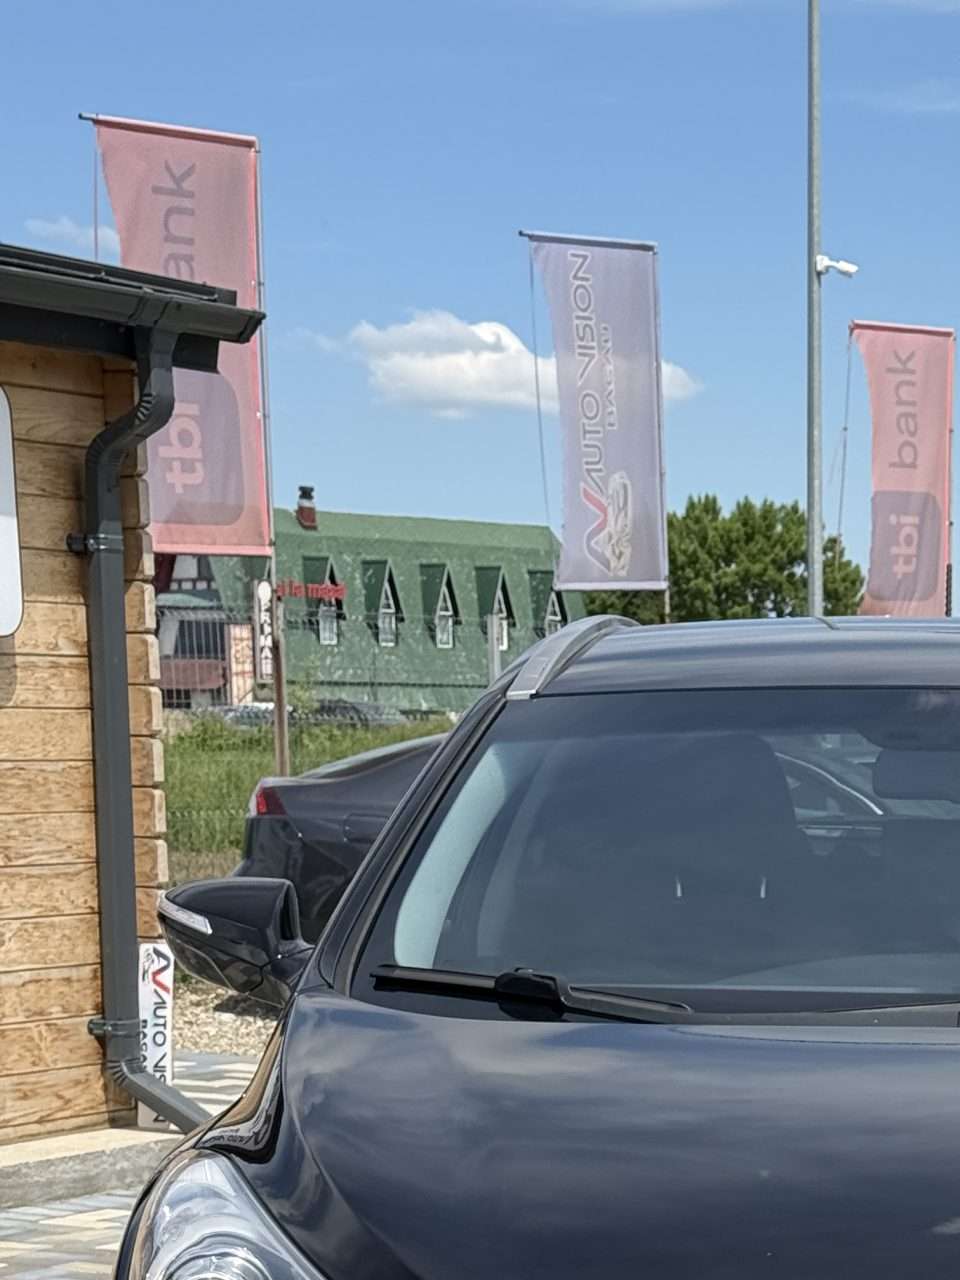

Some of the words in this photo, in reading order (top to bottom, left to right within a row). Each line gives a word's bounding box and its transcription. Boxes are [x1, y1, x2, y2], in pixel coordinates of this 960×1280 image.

[150, 159, 197, 279] ank
[567, 250, 599, 383] VISION
[579, 391, 606, 494] AUTO
[885, 349, 918, 470] bank
[889, 513, 920, 579] tbi
[153, 989, 167, 1047] AUTO
